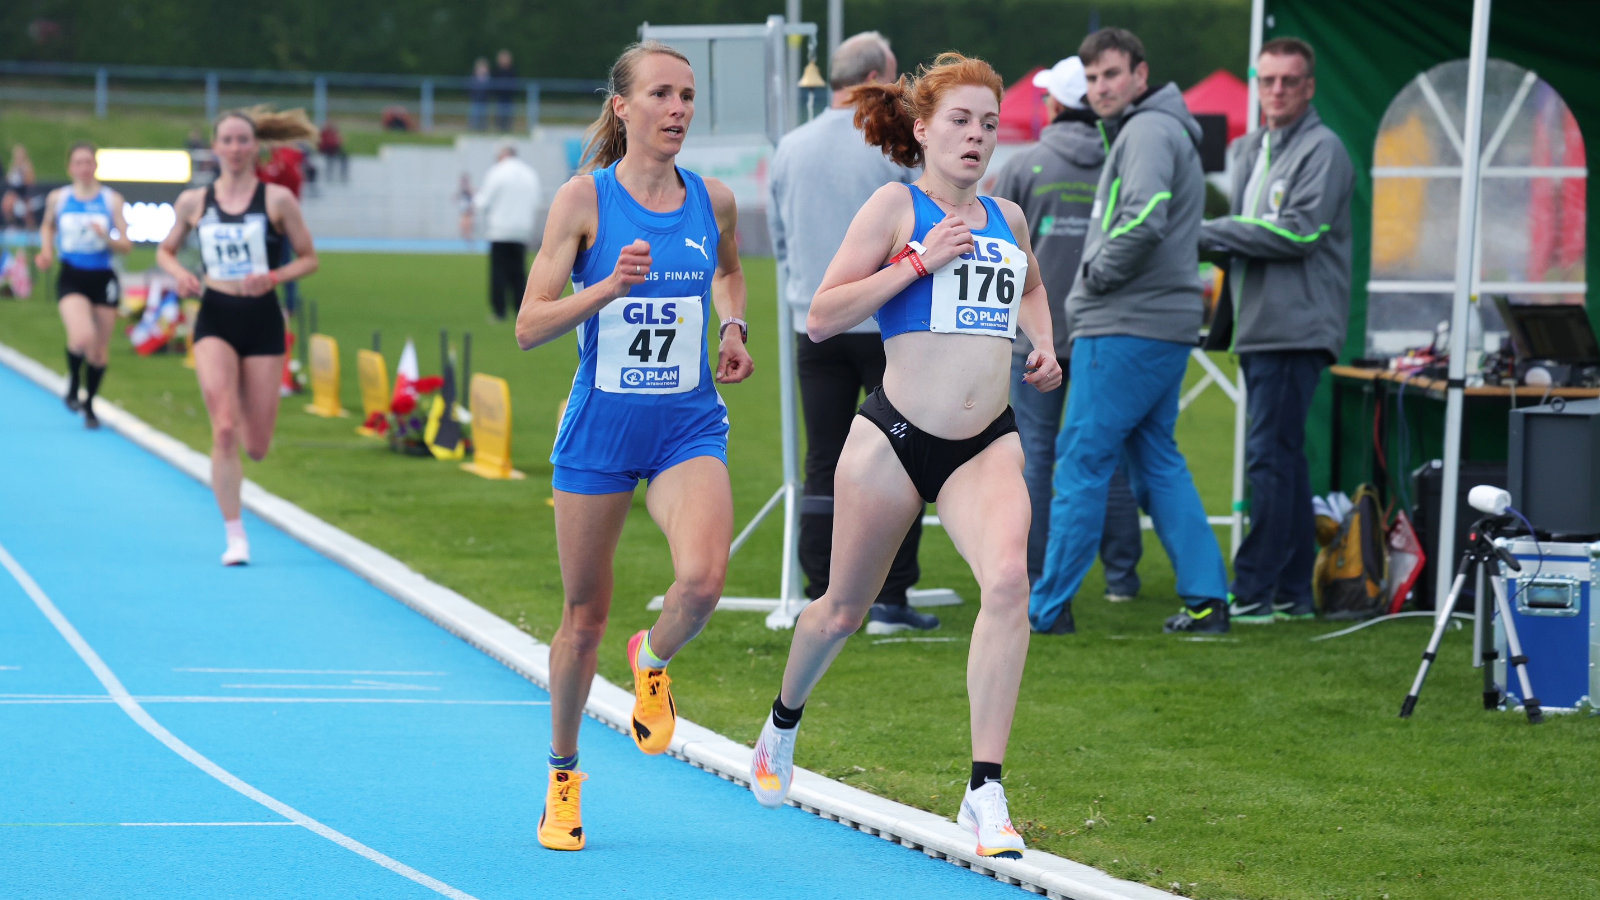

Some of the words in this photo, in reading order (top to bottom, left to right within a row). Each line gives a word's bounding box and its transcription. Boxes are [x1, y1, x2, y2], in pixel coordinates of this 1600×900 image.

[643, 271, 659, 281] LIS
[664, 271, 705, 281] FINANZ
[953, 263, 1015, 305] 176
[979, 310, 1009, 323] PLAN
[628, 328, 677, 363] 47
[645, 370, 678, 381] PLAN
